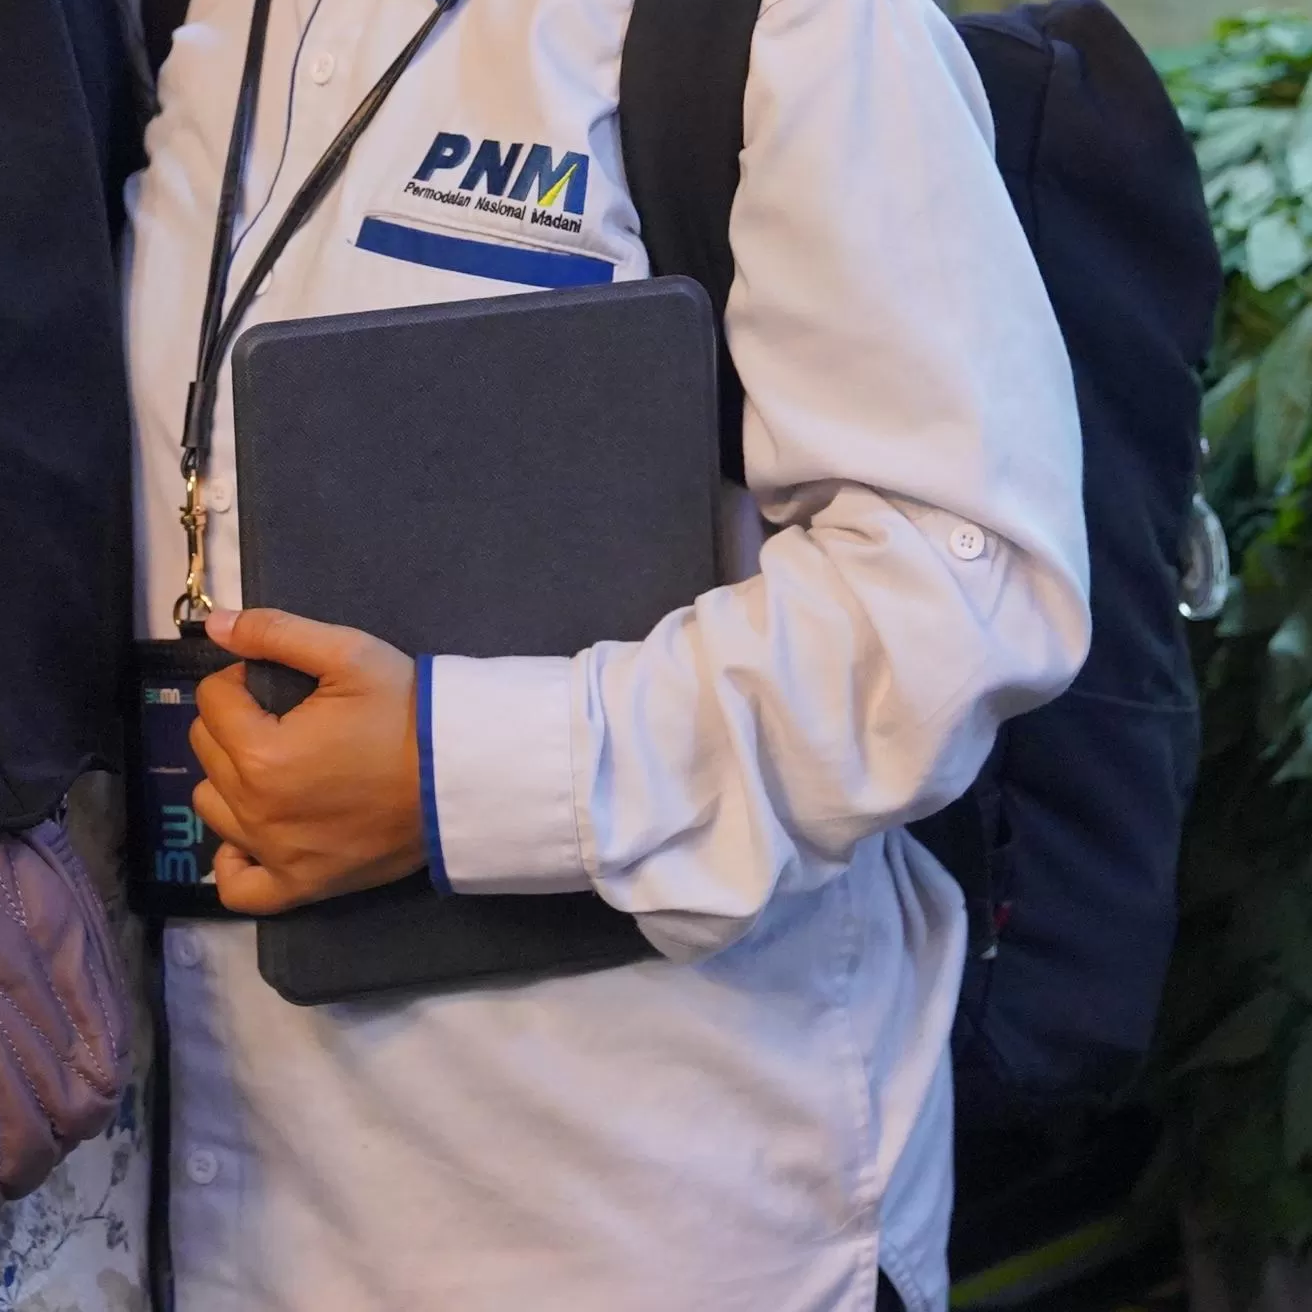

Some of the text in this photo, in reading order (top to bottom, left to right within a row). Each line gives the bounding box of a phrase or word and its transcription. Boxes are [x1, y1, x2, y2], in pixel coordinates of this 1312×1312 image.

[413, 131, 590, 215] PNM
[404, 181, 583, 234] Permodalan Nasional Madani
